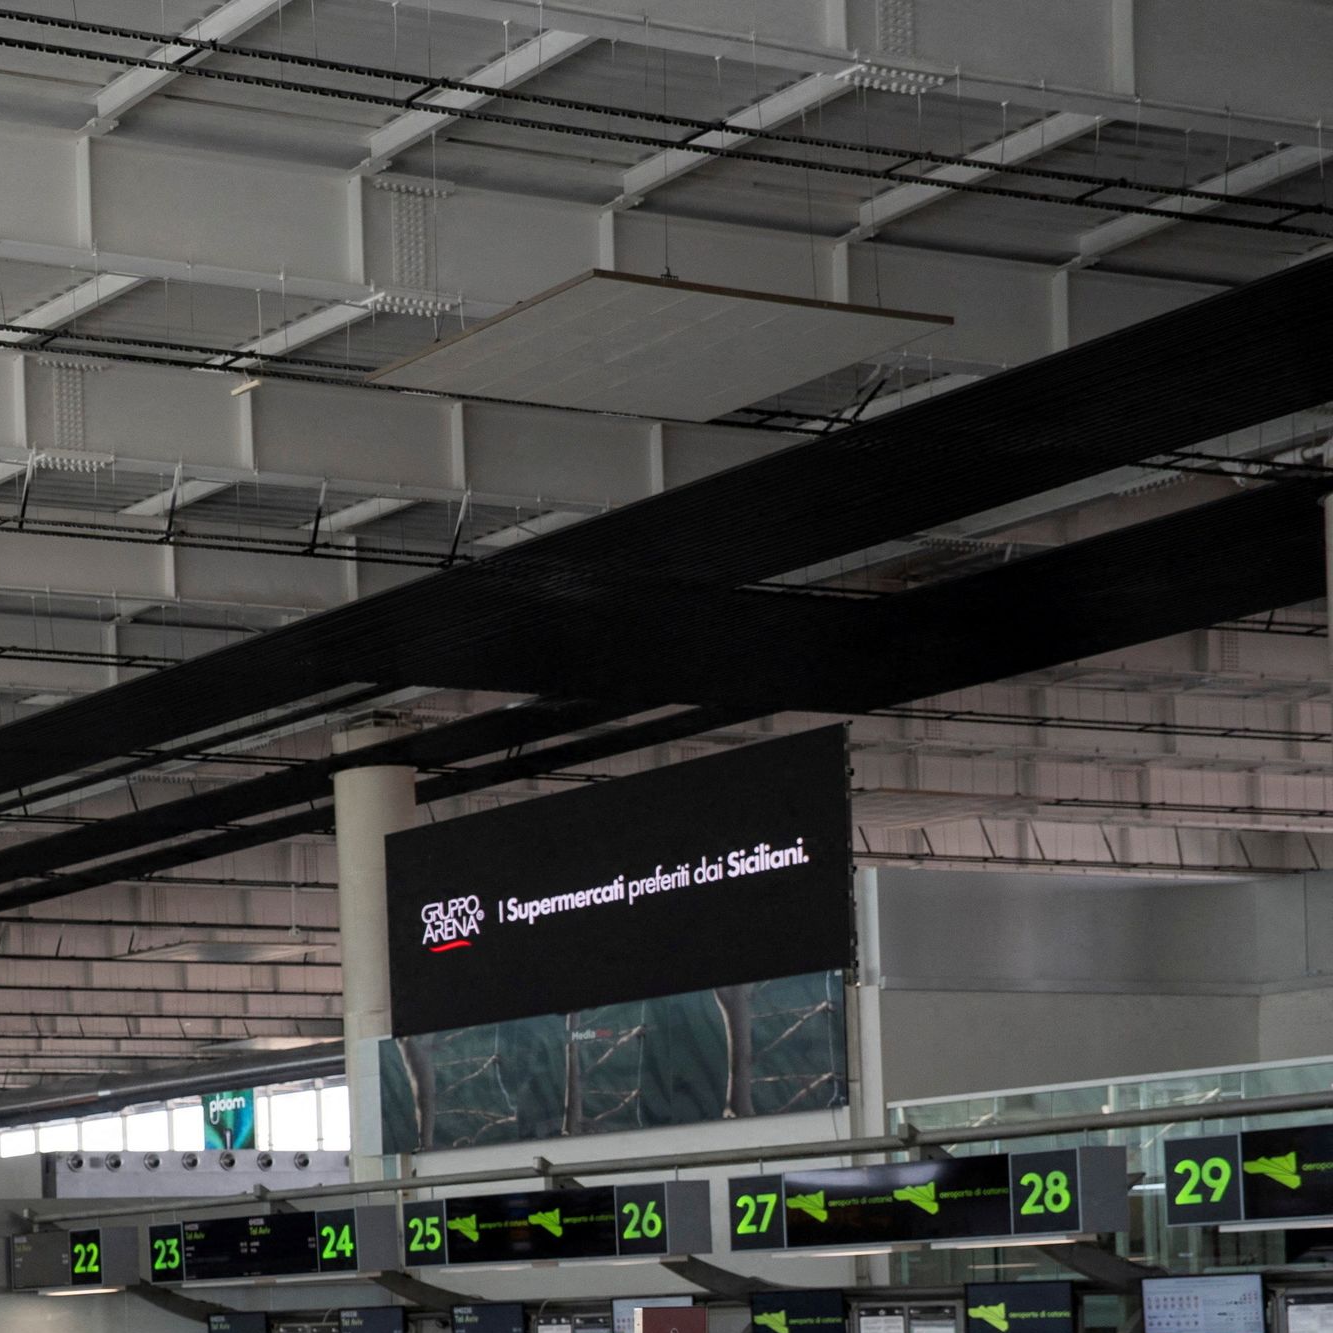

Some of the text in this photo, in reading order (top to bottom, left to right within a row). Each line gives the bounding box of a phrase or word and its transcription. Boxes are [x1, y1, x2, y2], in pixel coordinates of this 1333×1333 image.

[499, 838, 810, 924] I Supermercati preferiti dai Siciliani.
[421, 895, 480, 924] GRUPPO
[422, 916, 480, 945] ARENA
[939, 1190, 972, 1200] aeroporto
[1020, 1171, 1071, 1217] 28
[1174, 1157, 1231, 1205] 29
[622, 1200, 663, 1240] 26
[736, 1193, 777, 1234] 27
[321, 1224, 354, 1260] 24
[409, 1216, 442, 1252] 25
[73, 1243, 100, 1273] 22
[154, 1238, 181, 1270] 23
